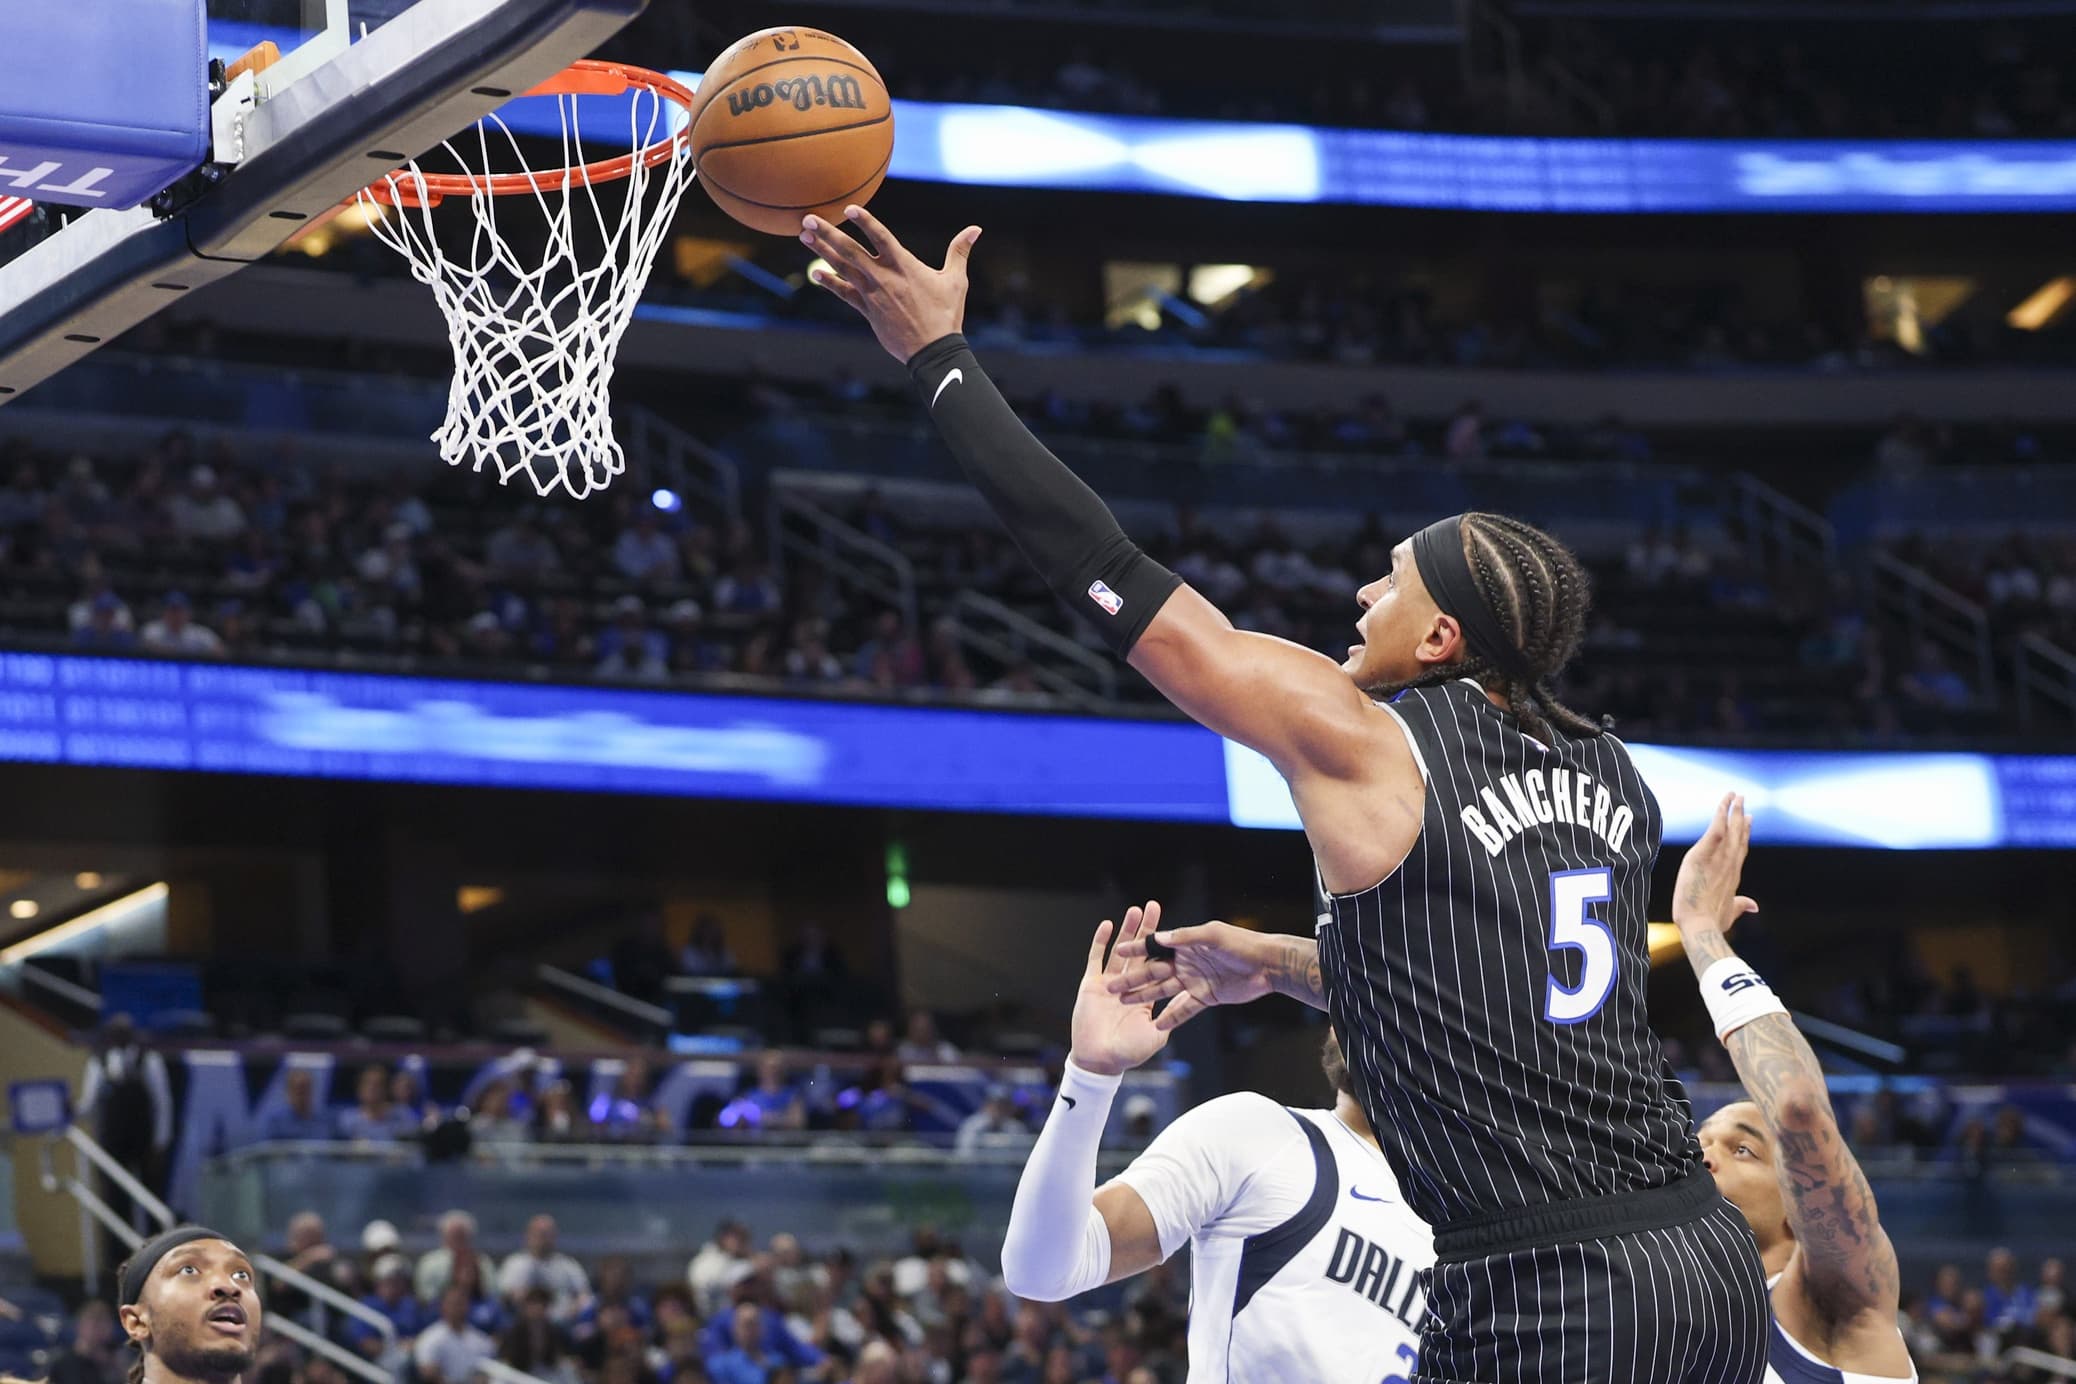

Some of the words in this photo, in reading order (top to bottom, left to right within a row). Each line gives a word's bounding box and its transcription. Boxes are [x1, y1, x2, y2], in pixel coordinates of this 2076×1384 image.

[728, 74, 866, 117] Wilson
[1460, 768, 1634, 857] BANCHERO
[1544, 866, 1619, 1025] 5
[1325, 1225, 1428, 1337] DALL
